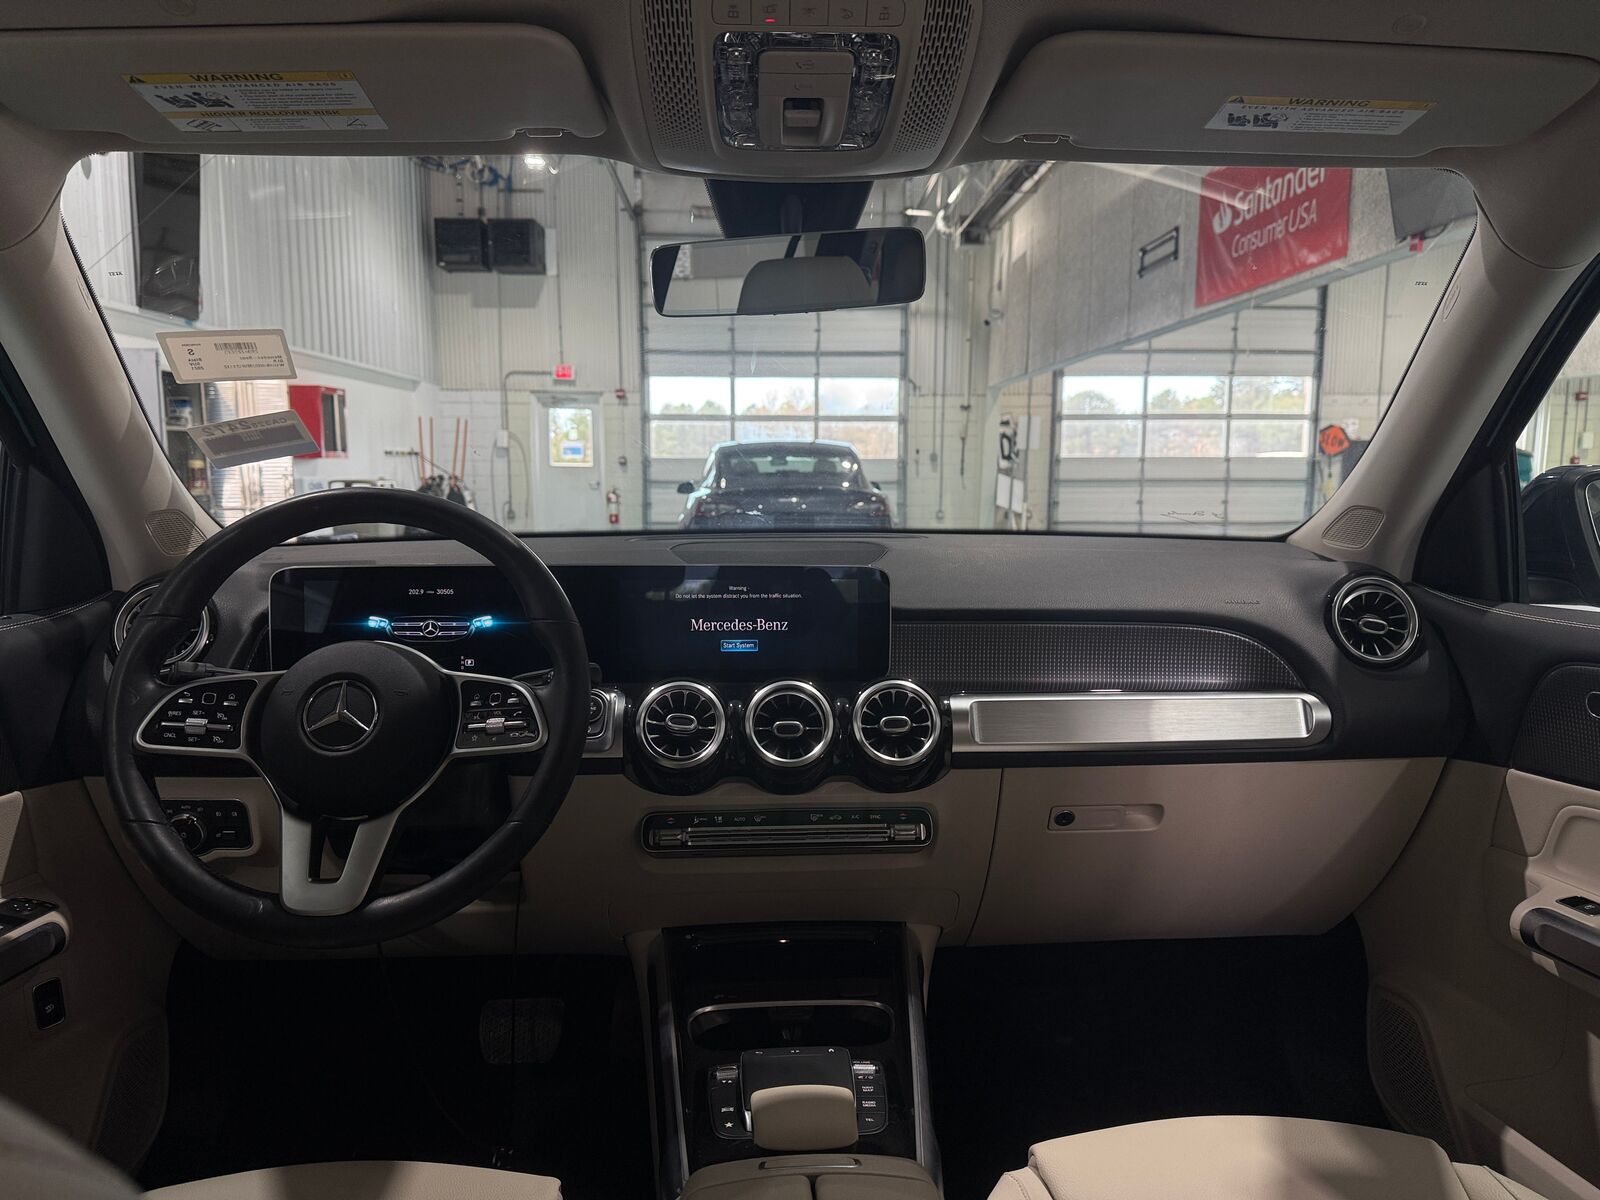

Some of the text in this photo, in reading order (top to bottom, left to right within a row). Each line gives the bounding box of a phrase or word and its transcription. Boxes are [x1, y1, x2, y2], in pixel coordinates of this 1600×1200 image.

[189, 72, 283, 81] WARNING
[1288, 98, 1370, 107] WARNING
[1233, 166, 1325, 226] Santander
[1231, 198, 1318, 258] Consumer USA
[690, 618, 789, 631] Mercedes-Benz
